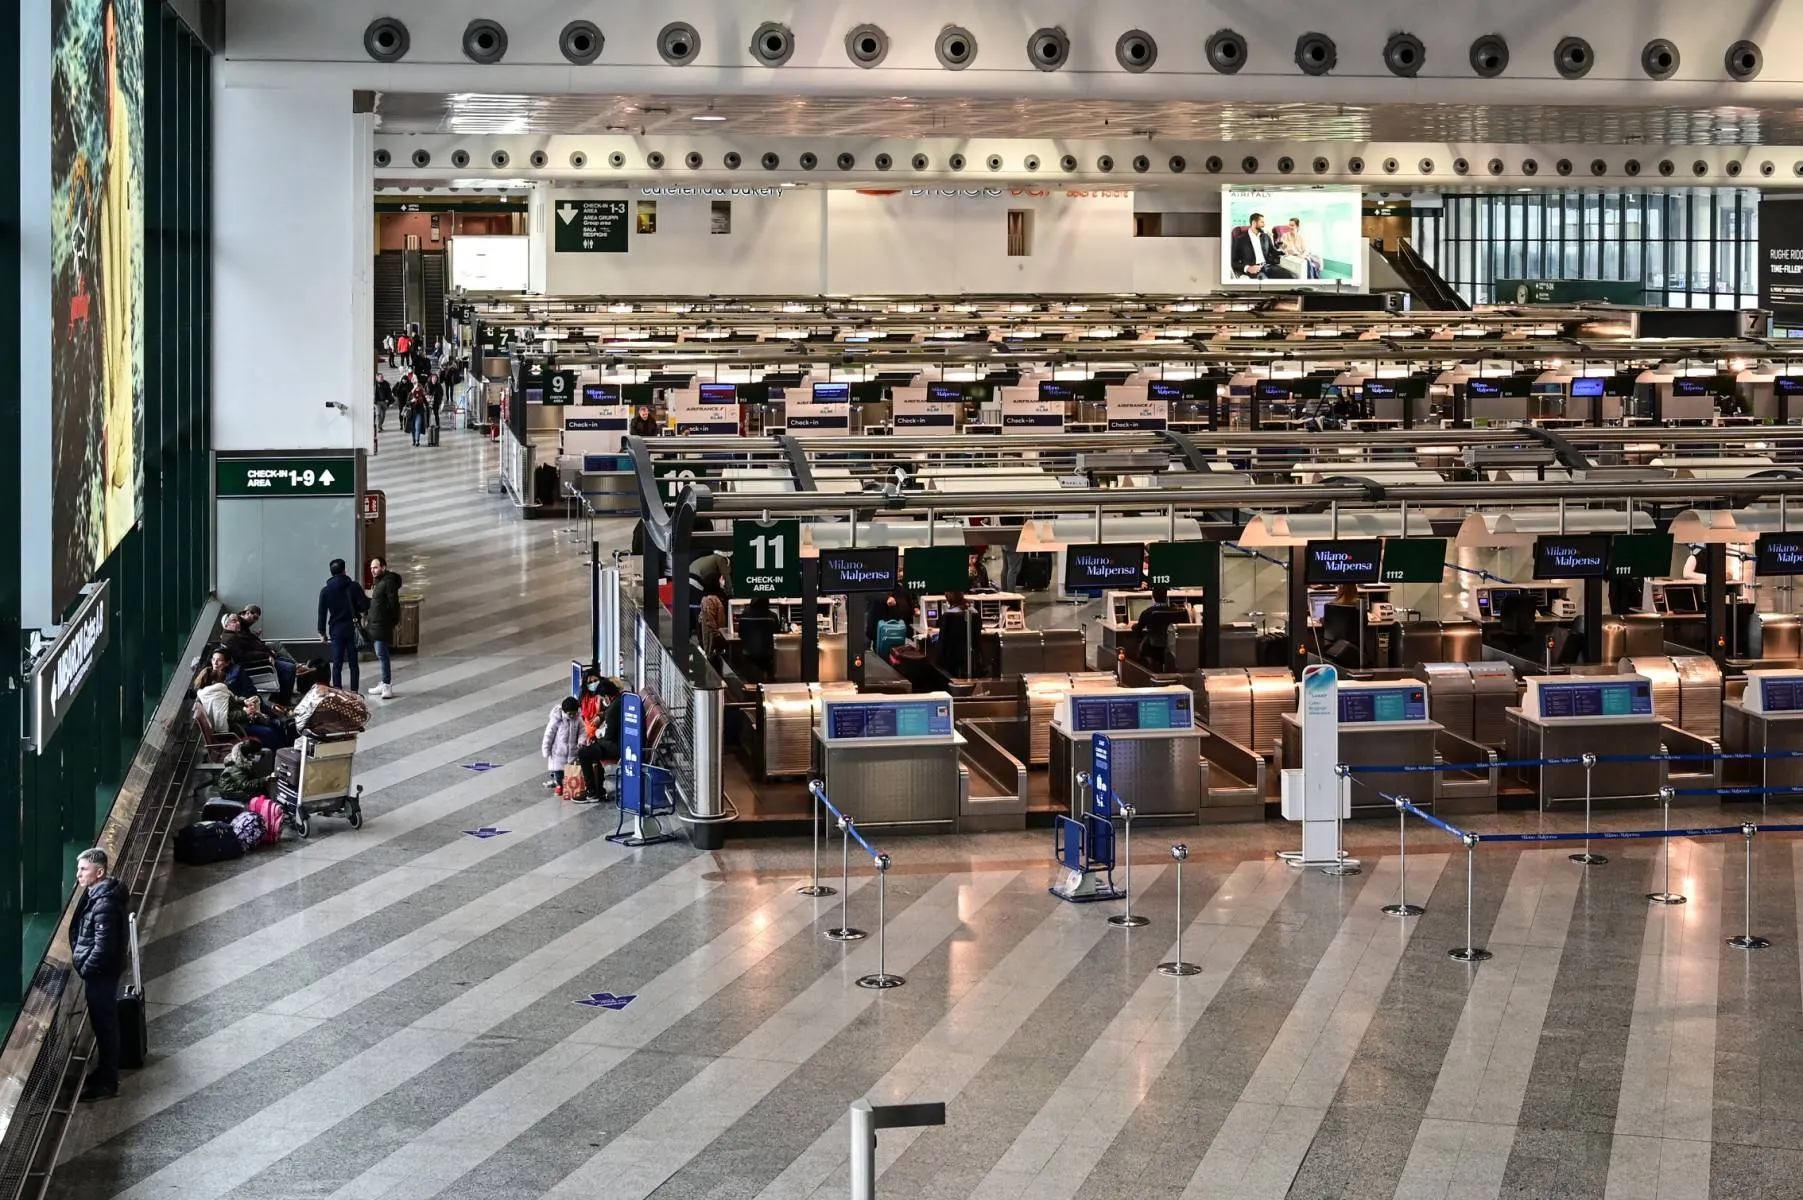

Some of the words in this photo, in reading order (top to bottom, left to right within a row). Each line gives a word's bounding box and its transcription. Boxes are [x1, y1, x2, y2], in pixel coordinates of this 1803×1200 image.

[610, 203, 625, 213] 1-3
[1390, 297, 1397, 306] 5
[463, 309, 470, 318] 5
[1749, 315, 1759, 329] 7
[500, 333, 509, 345] 7
[552, 376, 565, 393] 9
[247, 469, 288, 478] CHECK-IN
[289, 469, 315, 486] 1-9
[247, 479, 272, 487] AREA
[750, 535, 784, 569] 11
[1545, 546, 1577, 556] Milano
[1768, 543, 1799, 553] Milano
[1076, 555, 1110, 565] Milano
[1314, 551, 1348, 561] Milano
[828, 560, 863, 570] Milano
[1325, 561, 1373, 572] Malpensa
[1555, 556, 1600, 567] Malpensa
[840, 569, 890, 582] Malpensa
[1087, 565, 1136, 577] Malpensa
[1386, 571, 1404, 579] 1112
[1615, 566, 1631, 575] 1111
[907, 580, 926, 589] 1114
[1152, 575, 1170, 584] 1113
[753, 584, 776, 592] AREA
